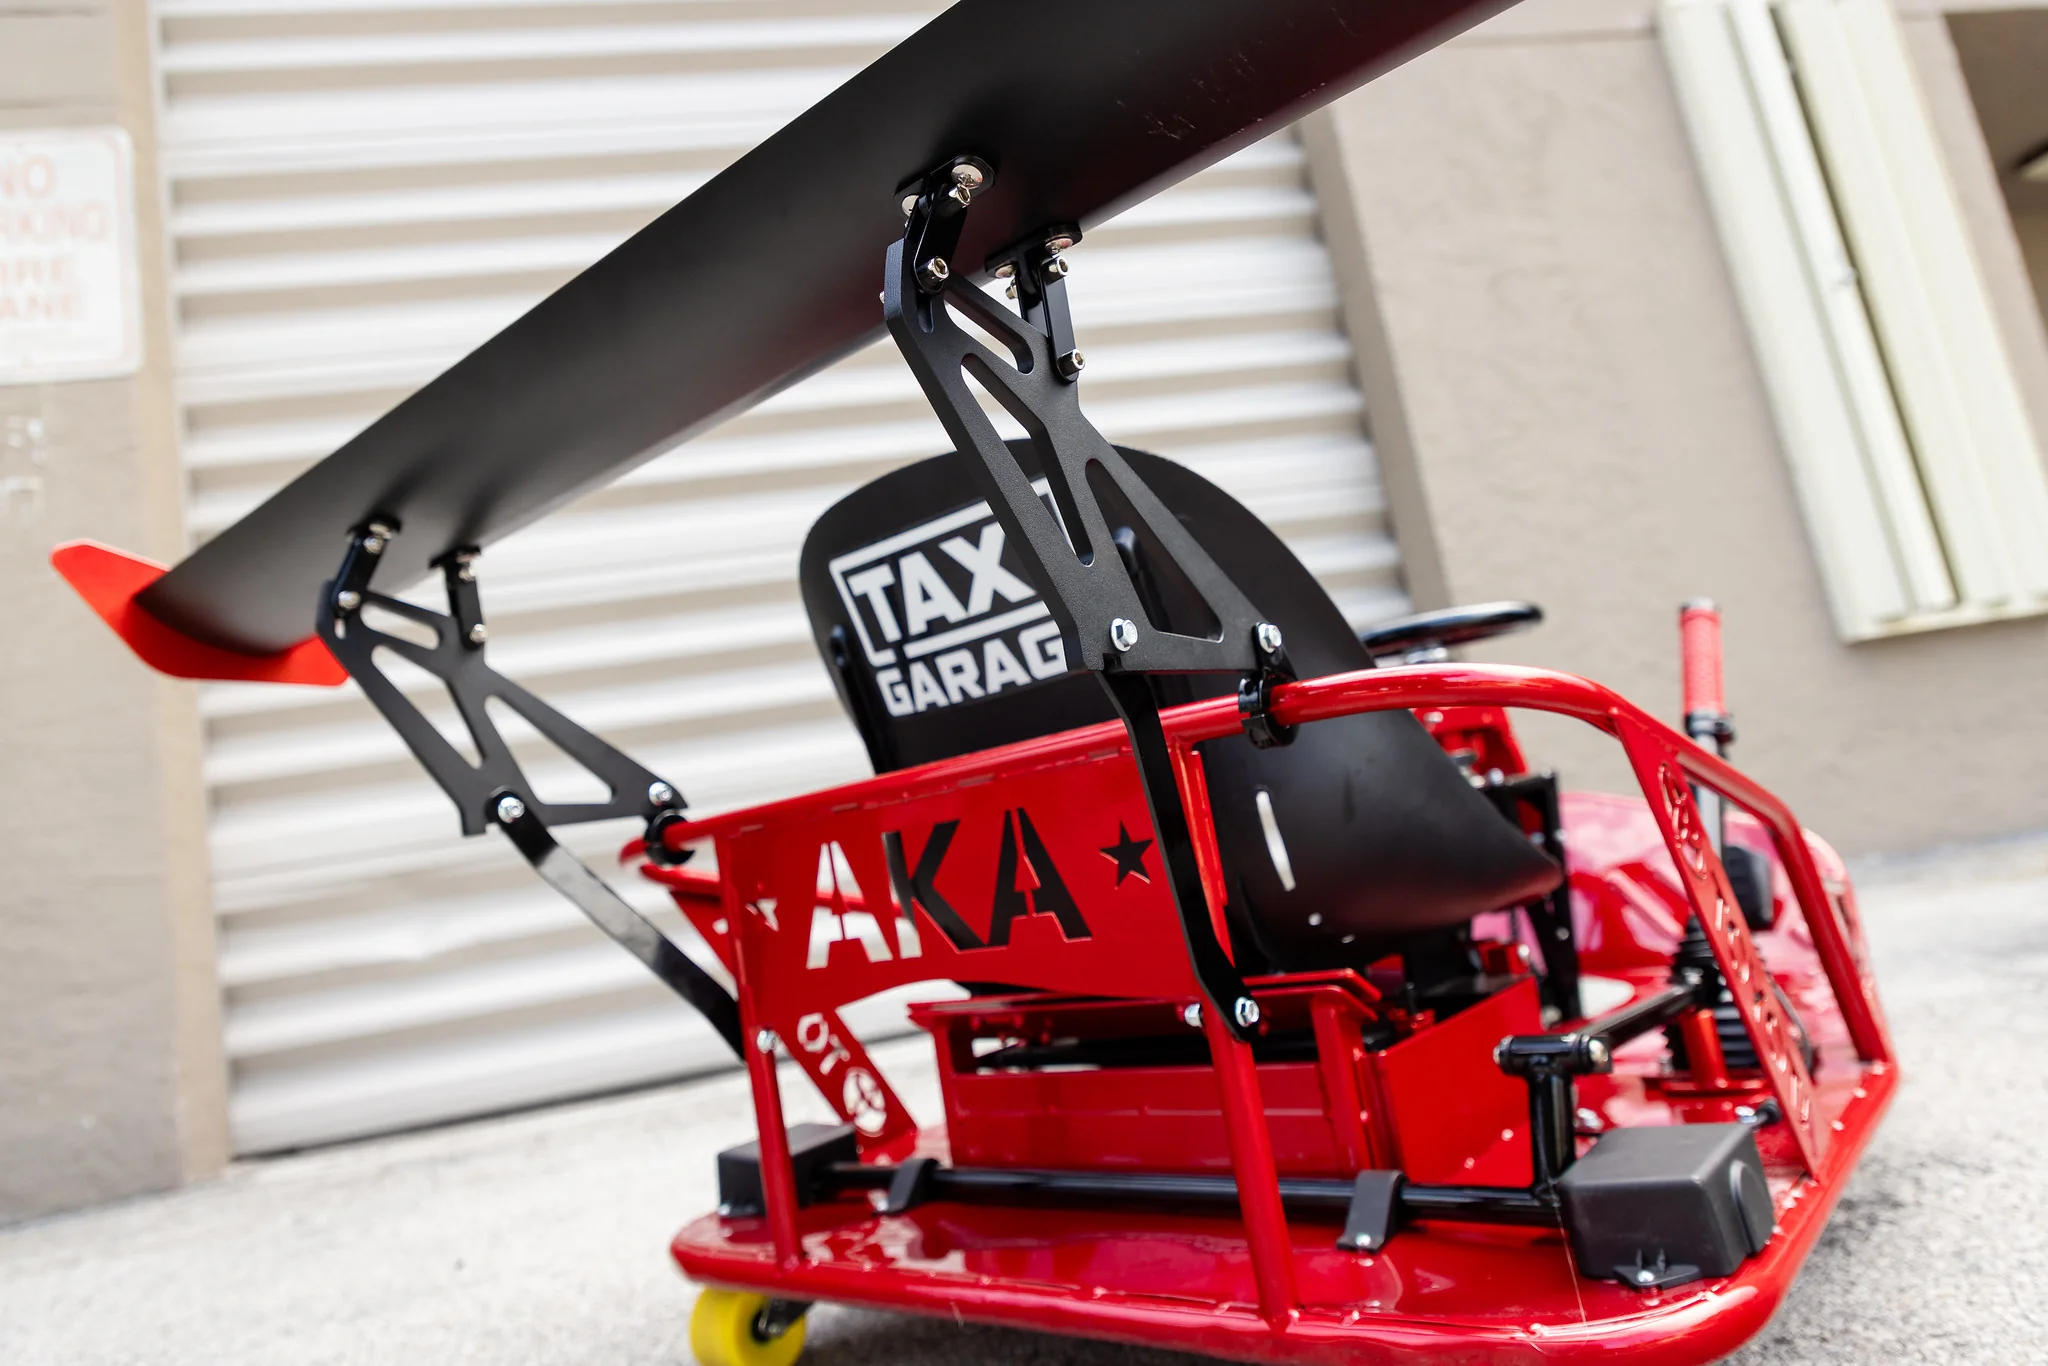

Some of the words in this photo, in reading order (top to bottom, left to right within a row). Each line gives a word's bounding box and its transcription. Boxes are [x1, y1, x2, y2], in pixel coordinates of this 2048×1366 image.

[847, 521, 1036, 643] TAX
[876, 620, 1068, 717] GARAG
[806, 807, 1093, 970] AKA
